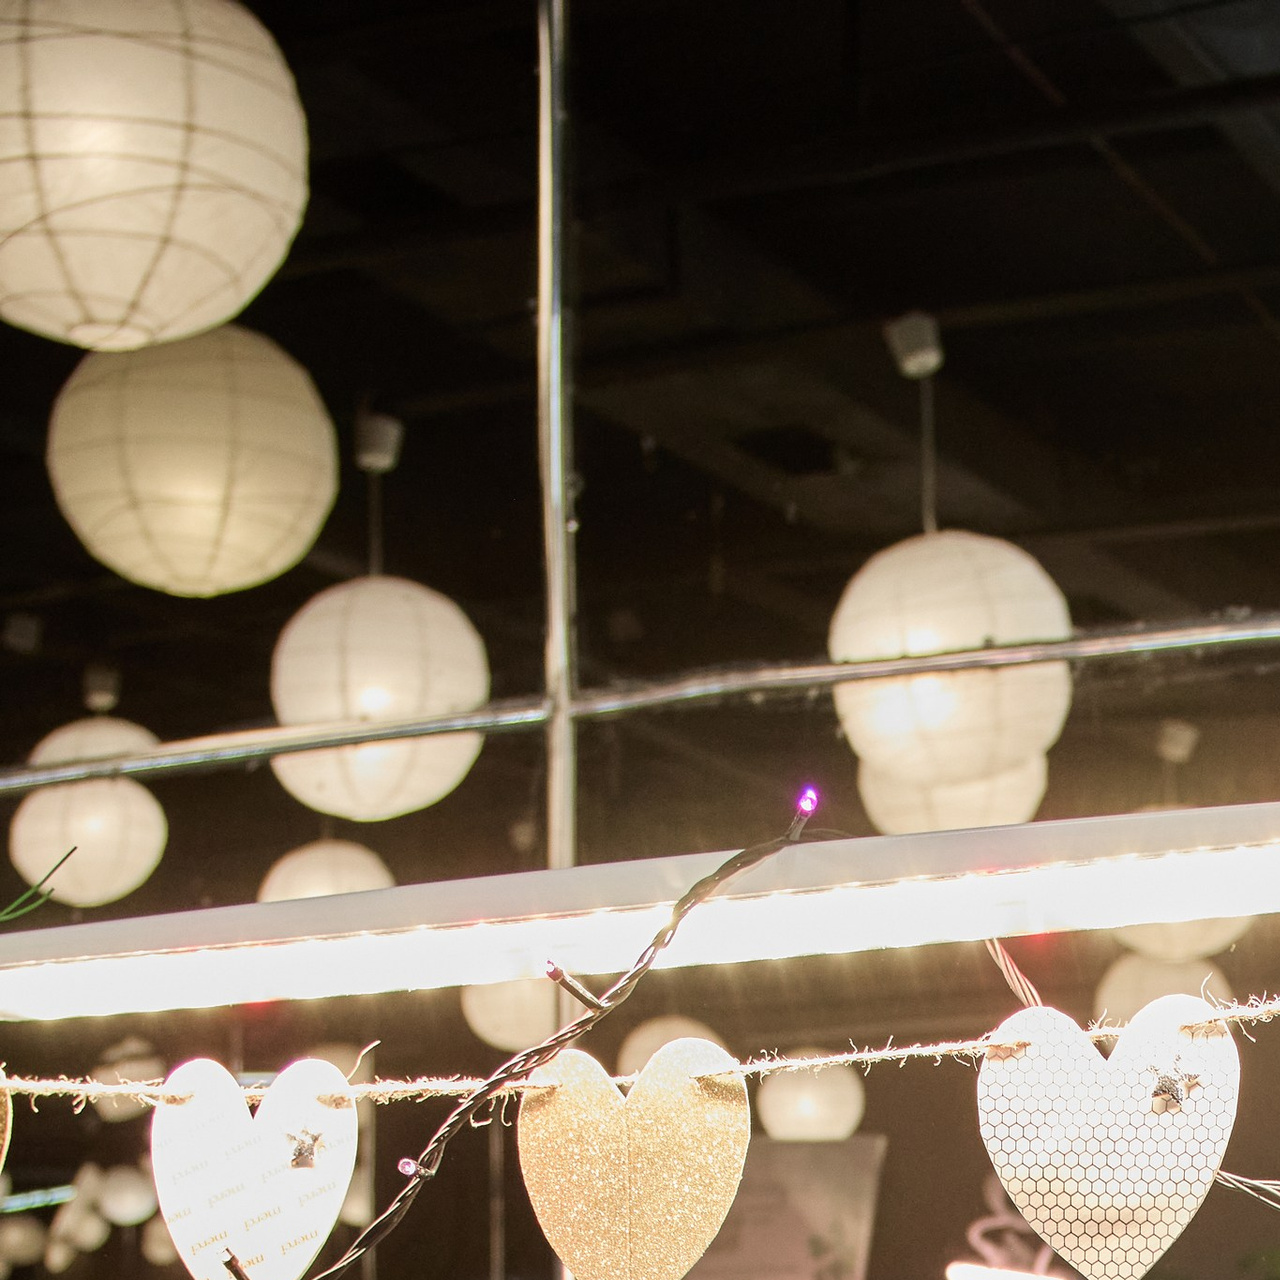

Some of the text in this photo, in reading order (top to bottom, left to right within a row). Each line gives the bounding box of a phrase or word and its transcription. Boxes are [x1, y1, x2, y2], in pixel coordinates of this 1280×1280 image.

[244, 1206, 281, 1232] merci
[191, 1230, 229, 1256] merci
[281, 1230, 318, 1256] merci
